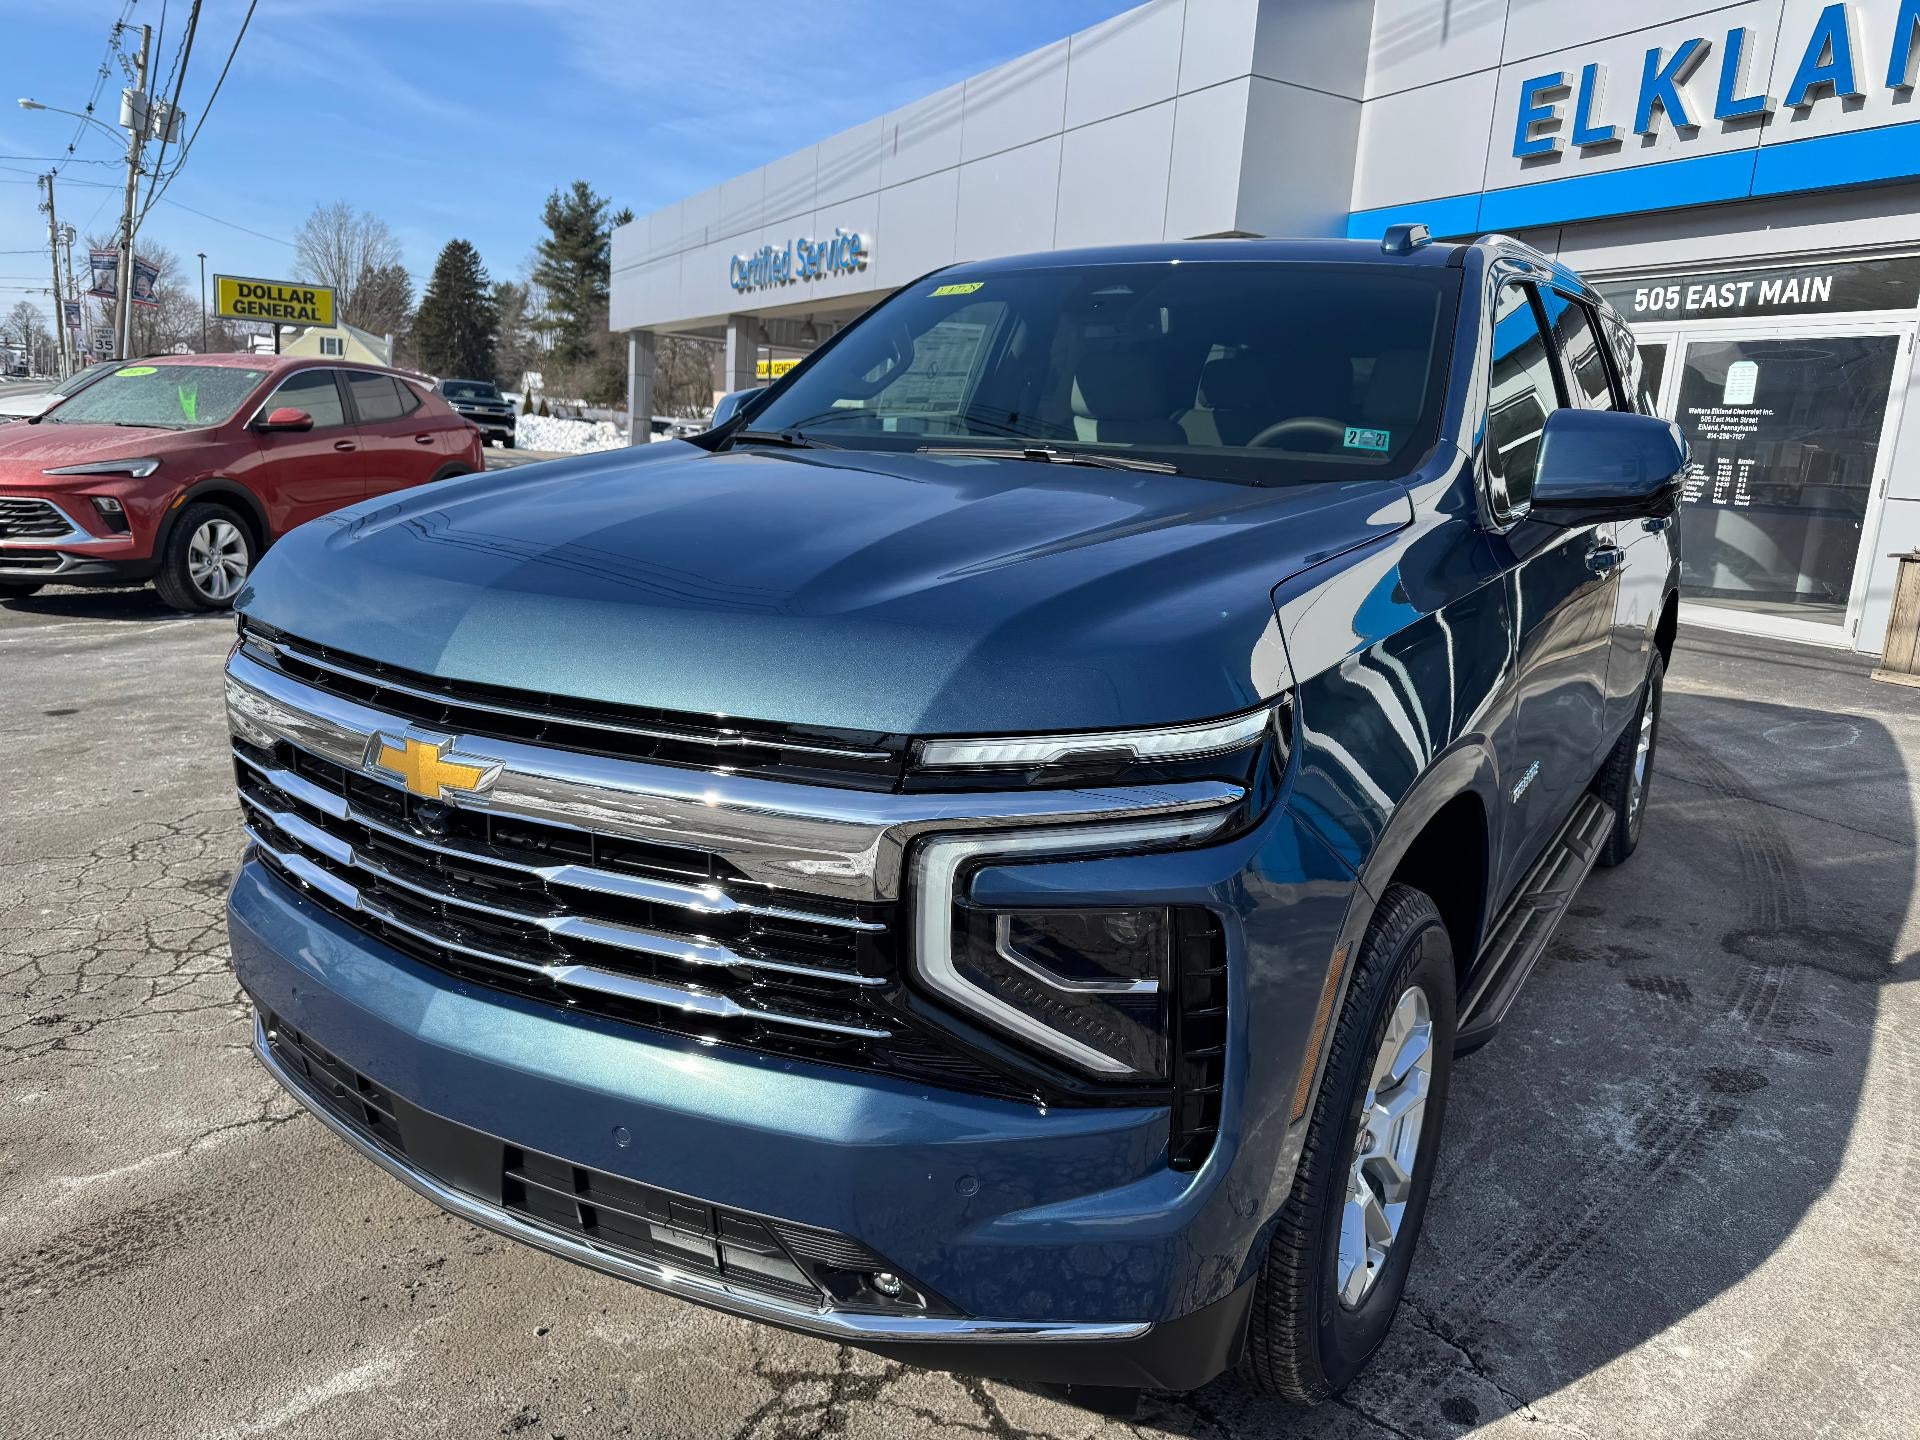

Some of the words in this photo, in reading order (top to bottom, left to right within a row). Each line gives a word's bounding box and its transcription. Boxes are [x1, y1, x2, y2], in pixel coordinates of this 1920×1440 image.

[730, 240, 793, 289] Certified
[796, 228, 864, 277] Service
[237, 283, 316, 305] DOLLAR
[1634, 286, 1681, 311] 505
[1686, 281, 1753, 309] EAST
[1758, 276, 1833, 305] MAIN
[233, 300, 321, 320] GENERAL
[95, 340, 114, 350] 35
[1720, 424, 1758, 432] Pennsylvania
[1349, 431, 1357, 444] 2
[1376, 433, 1386, 447] 27
